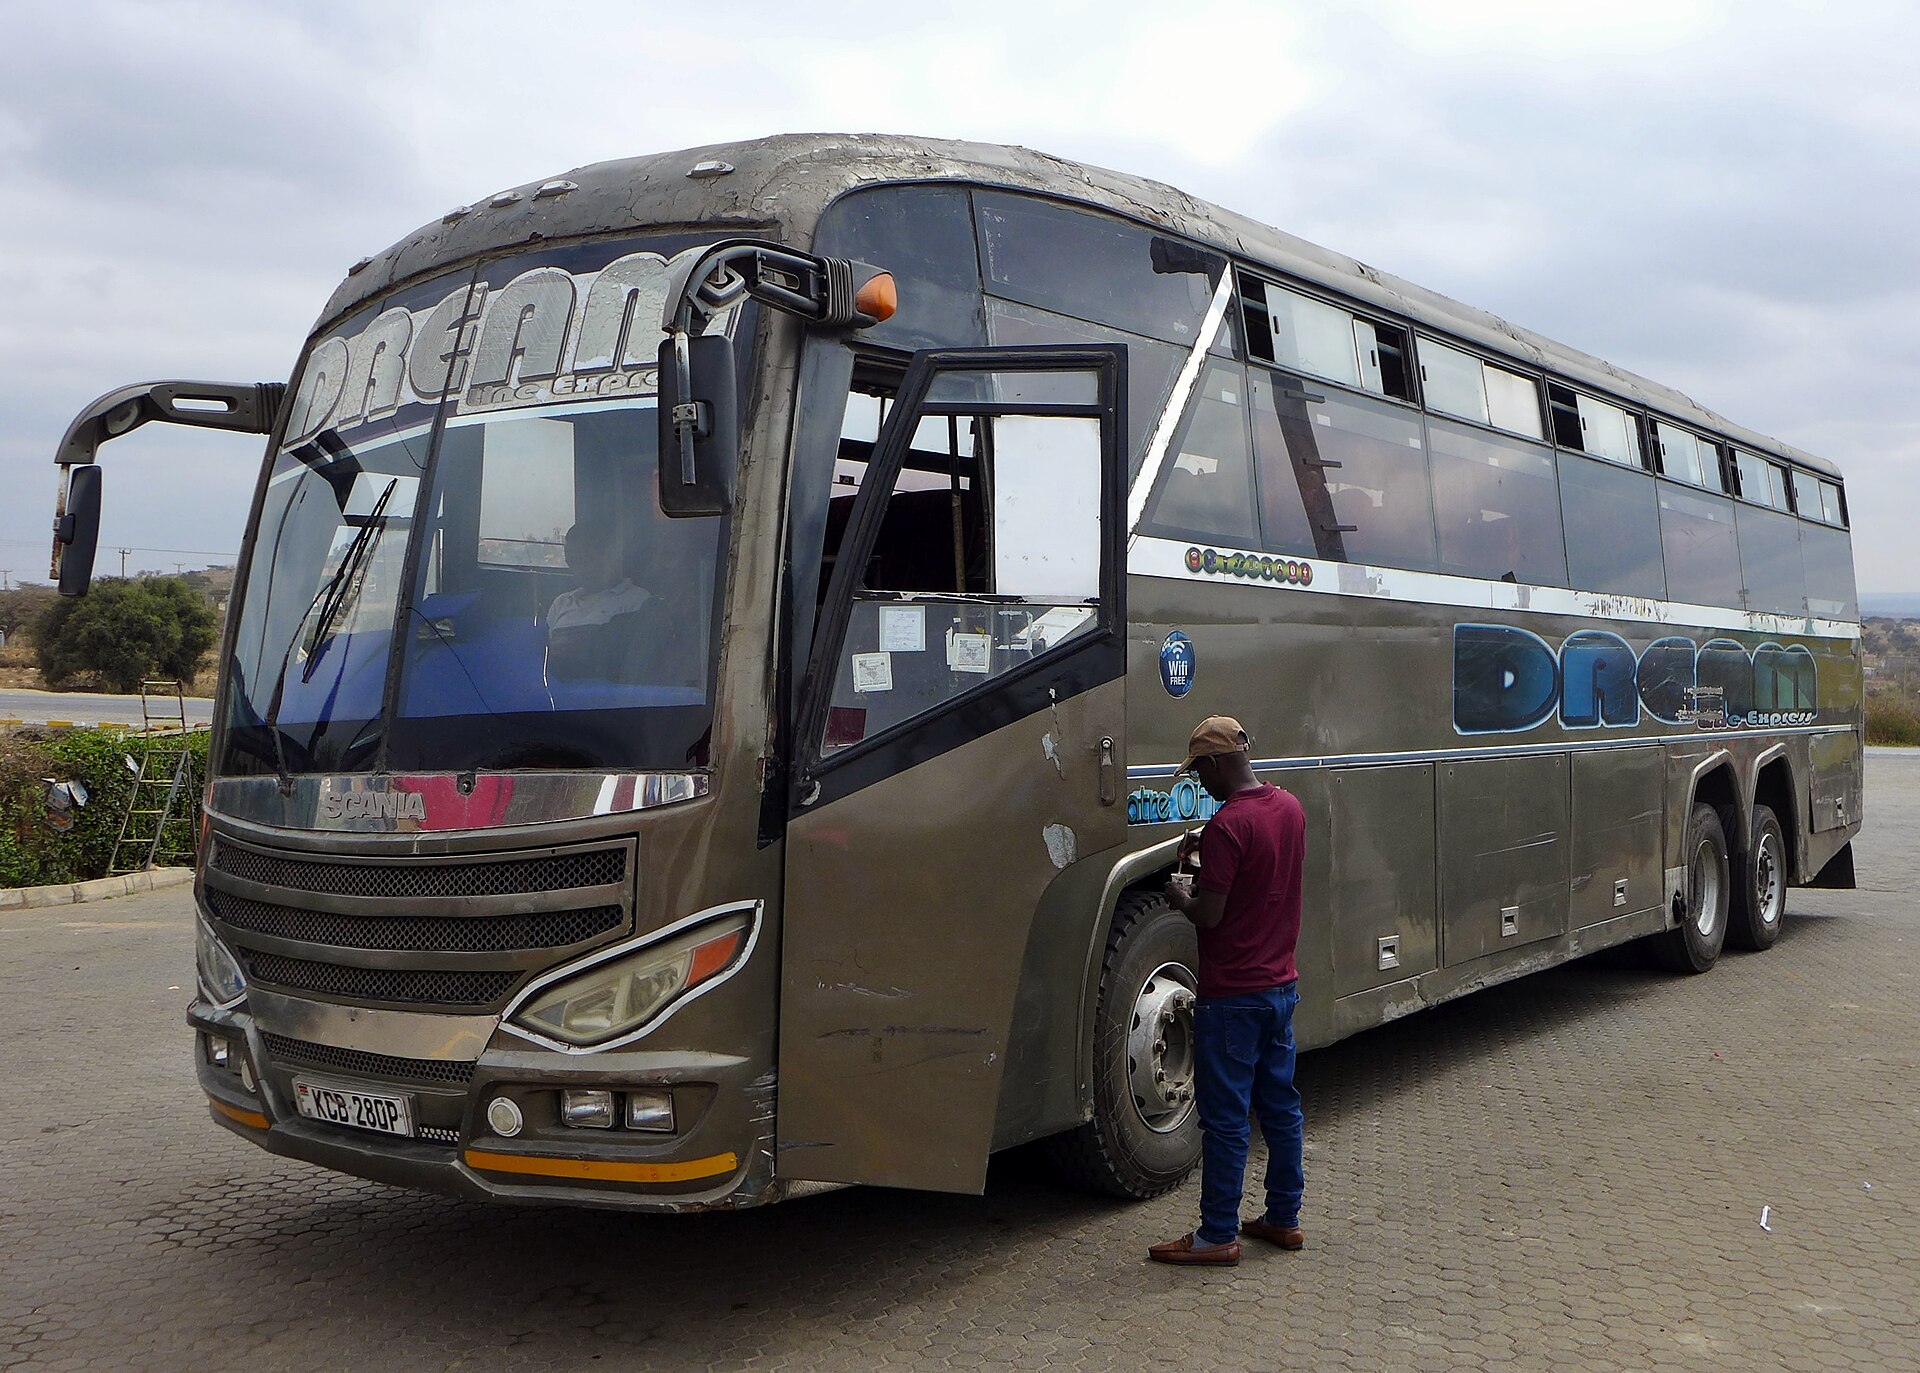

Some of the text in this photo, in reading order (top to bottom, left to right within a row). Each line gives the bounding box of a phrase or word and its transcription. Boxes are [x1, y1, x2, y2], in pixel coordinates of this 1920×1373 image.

[552, 370, 659, 396] Expr
[1168, 660, 1188, 676] Wifi
[1170, 676, 1186, 686] FREE
[326, 791, 427, 821] SCANIA
[311, 1088, 398, 1132] KCB 280P
